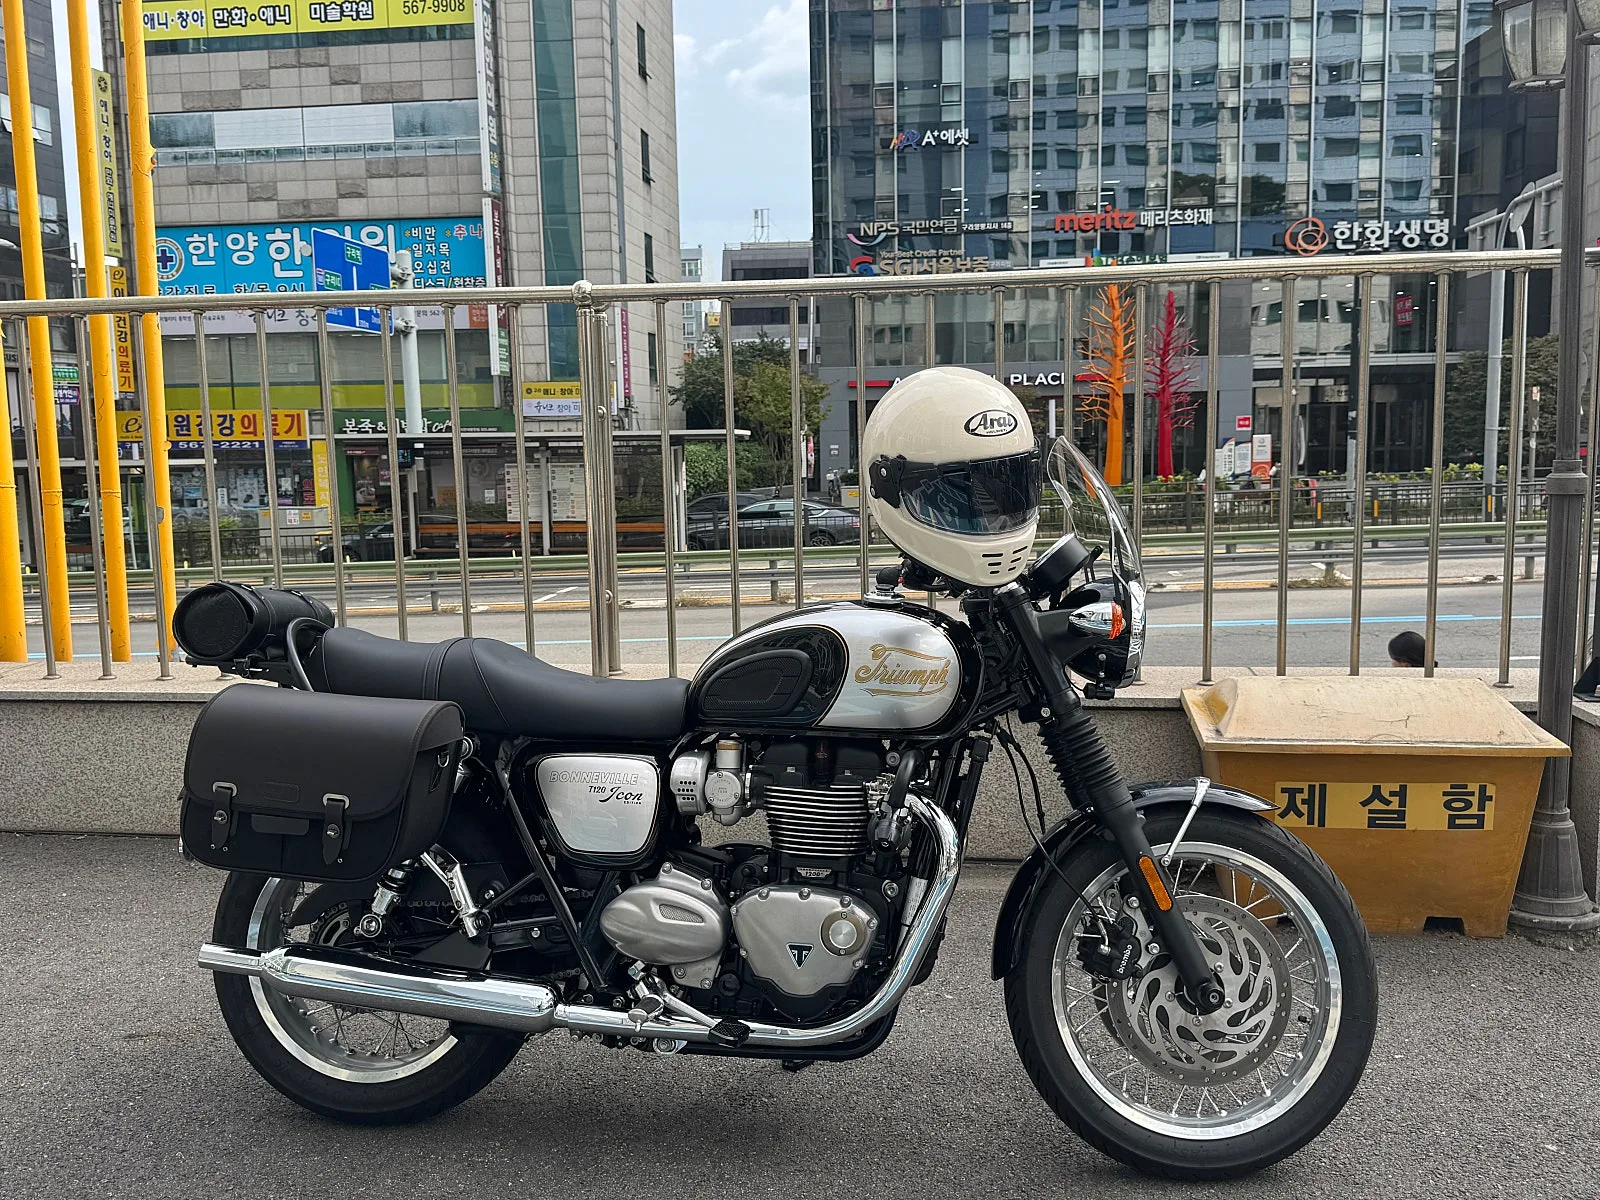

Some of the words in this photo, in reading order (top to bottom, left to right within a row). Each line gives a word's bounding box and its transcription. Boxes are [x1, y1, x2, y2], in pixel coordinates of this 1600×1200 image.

[310, 2, 374, 23] 미술학원
[402, 0, 466, 15] 567-9908
[482, 0, 499, 145] 양한의원
[860, 221, 900, 236] NPS
[902, 218, 958, 235] 국민연금
[1055, 204, 1137, 232] meritz
[1140, 208, 1213, 227] 메리츠화재
[411, 226, 436, 241] 비만
[1333, 219, 1450, 249] 한화생명
[412, 242, 450, 258] 일자목
[412, 260, 451, 275] 오십견
[112, 287, 132, 389] 이건강의료기
[1010, 373, 1065, 386] PLAC
[976, 412, 1014, 431] Arai
[855, 644, 951, 697] Triumph
[549, 770, 639, 785] BONNEVILLE
[588, 785, 607, 794] T120
[598, 786, 644, 803] Icon
[1116, 944, 1133, 974] brembo
